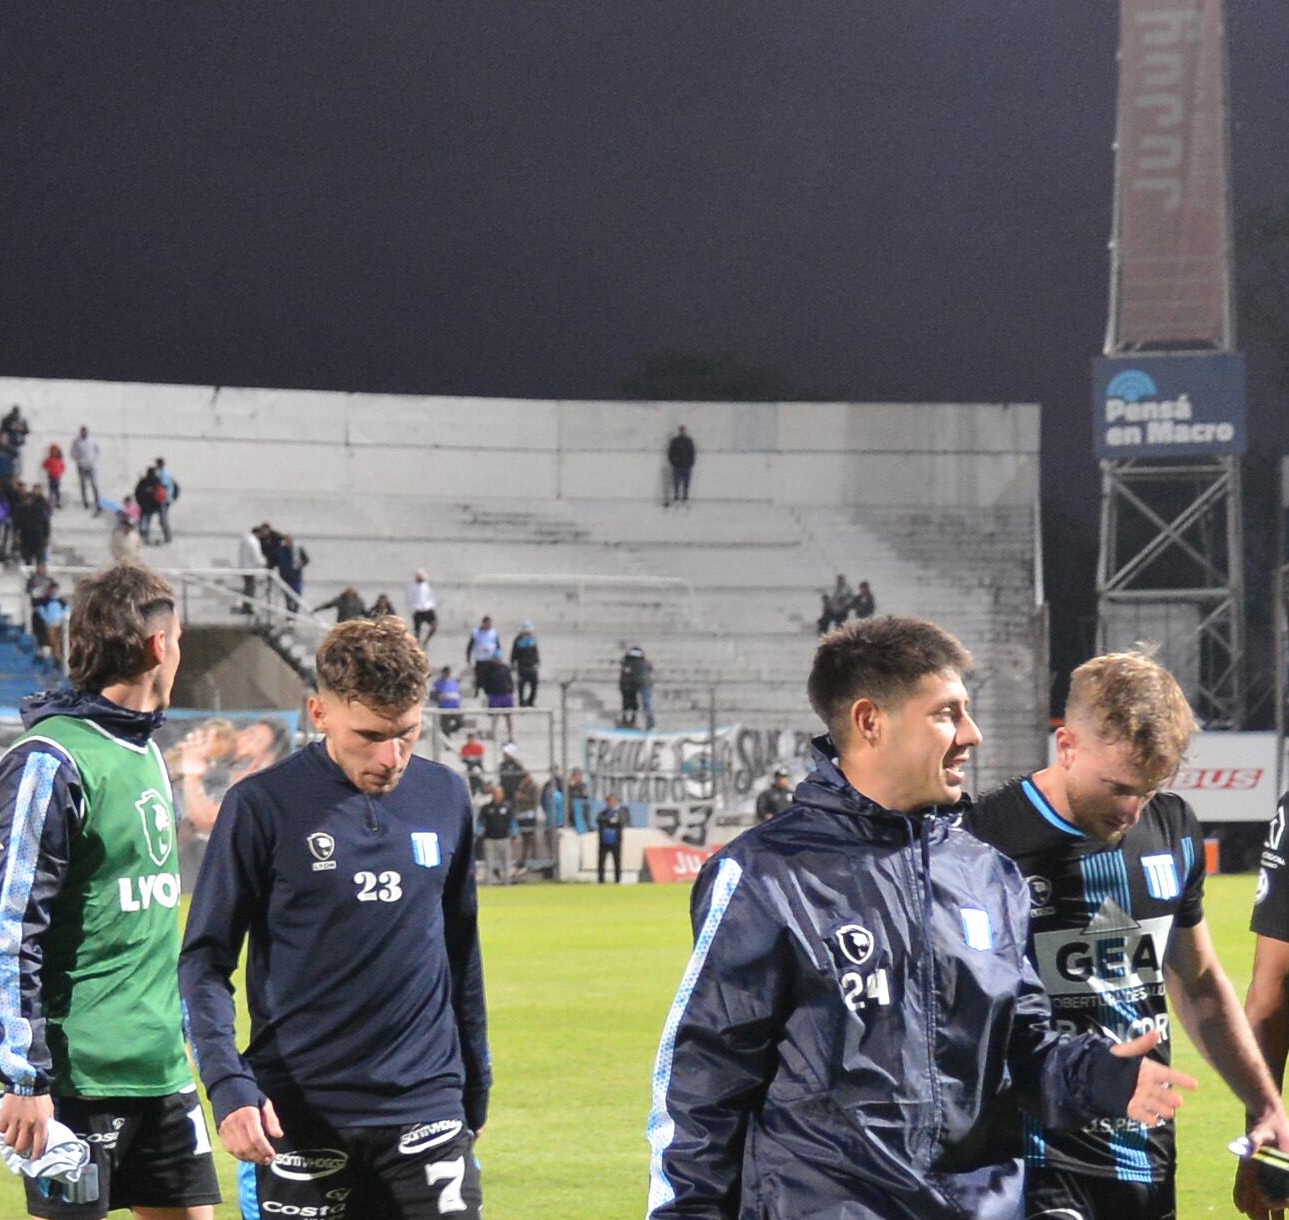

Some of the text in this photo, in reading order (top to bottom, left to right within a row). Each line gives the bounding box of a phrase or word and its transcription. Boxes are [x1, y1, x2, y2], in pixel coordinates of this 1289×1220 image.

[1105, 393, 1192, 422] Pensá
[1106, 419, 1234, 446] en Macro
[118, 872, 180, 912] LYO
[353, 871, 403, 902] 23
[1056, 933, 1160, 983] GEA
[840, 968, 891, 1012] 24
[424, 1155, 468, 1215] 7
